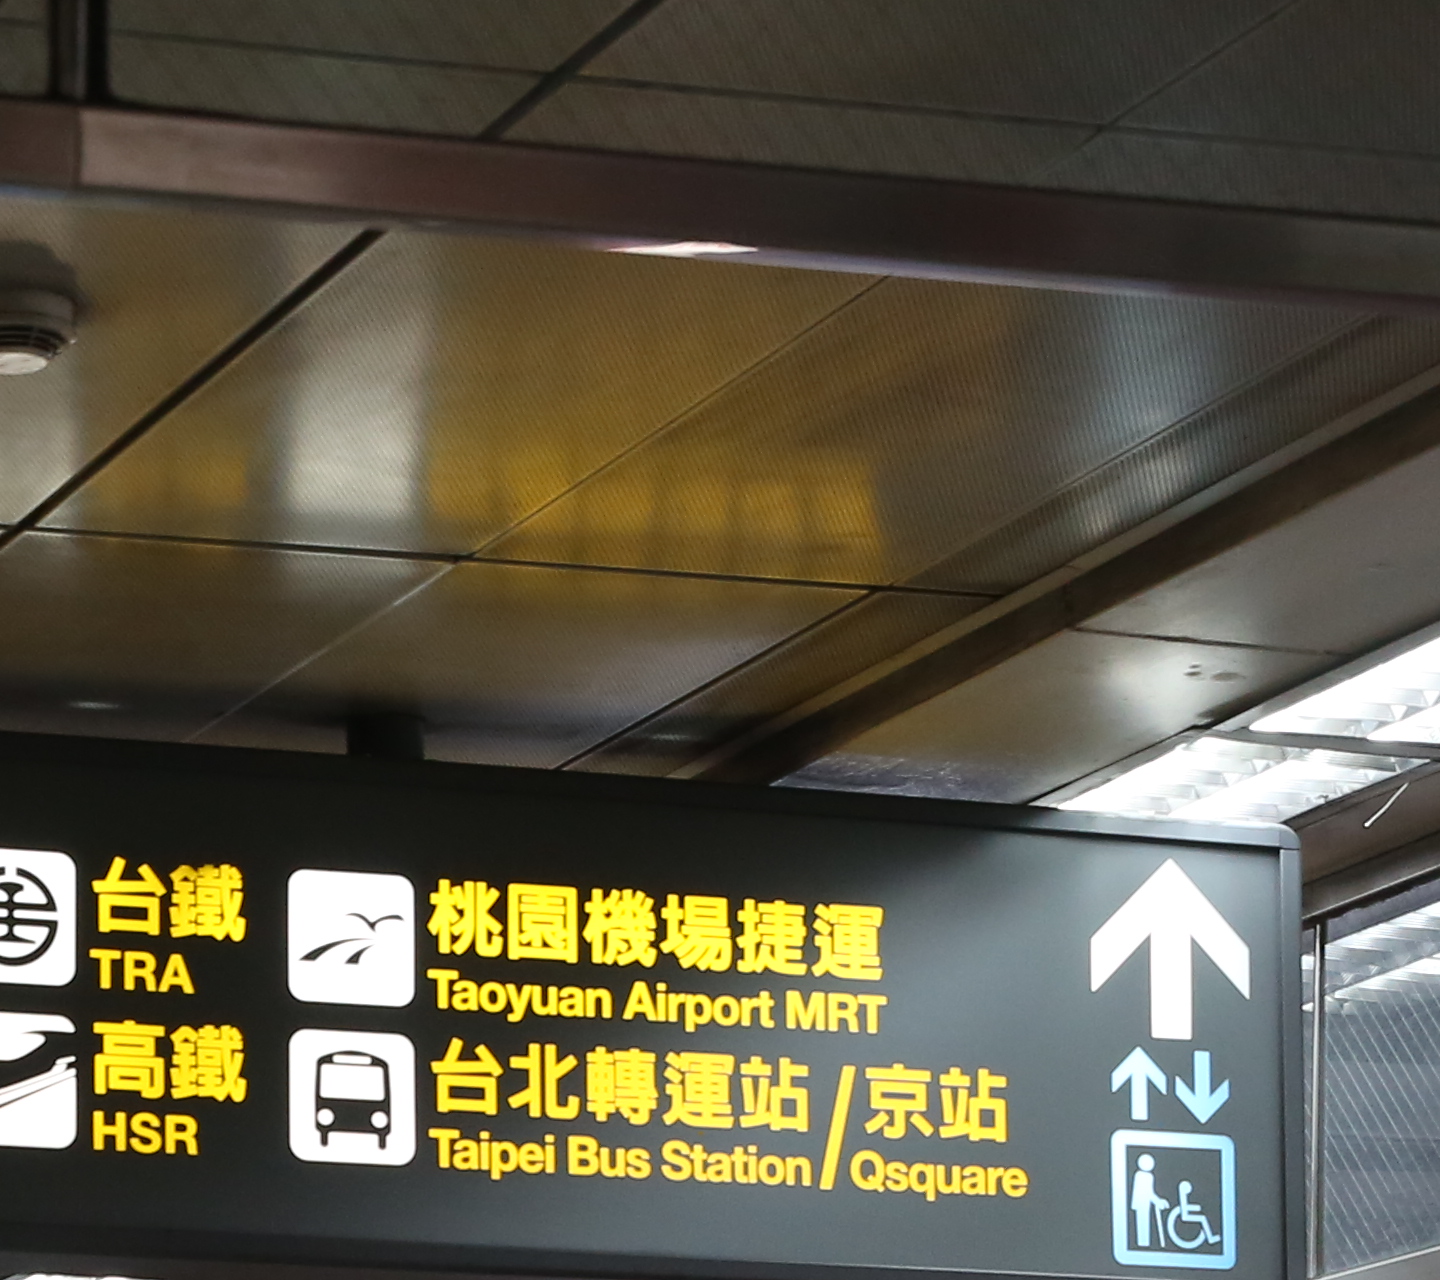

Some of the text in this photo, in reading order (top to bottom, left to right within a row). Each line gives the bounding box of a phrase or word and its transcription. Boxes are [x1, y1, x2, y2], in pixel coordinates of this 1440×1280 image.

[92, 857, 246, 941] 台鐵
[427, 879, 884, 983] 桃園機場捷運
[91, 950, 194, 995] TRA
[428, 970, 886, 1034] Taoyuan Airport MRT
[93, 1020, 247, 1102] 高鐵
[93, 1111, 198, 1155] HSR
[428, 1127, 554, 1182] Taipei
[566, 1135, 651, 1181] Bus
